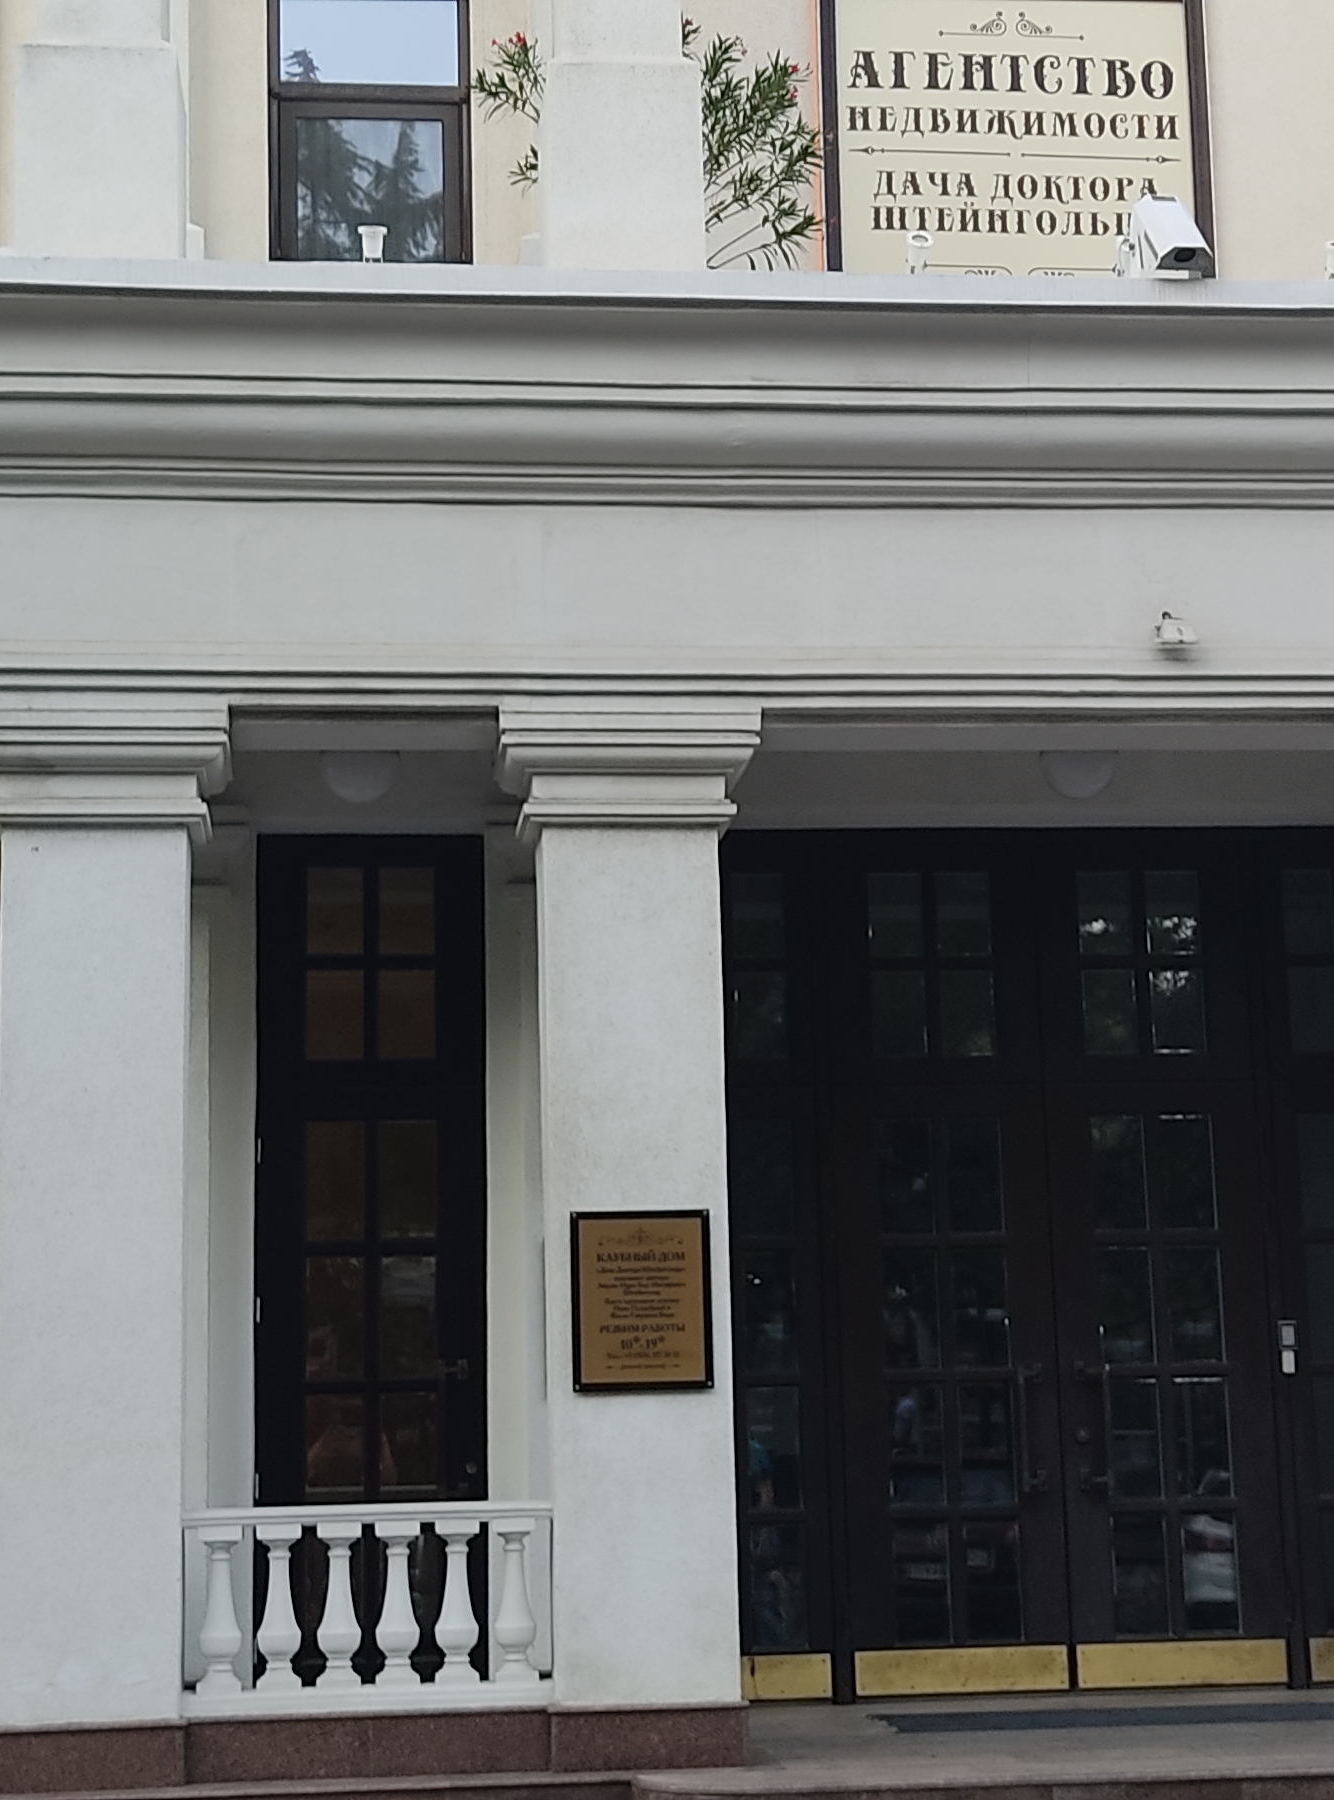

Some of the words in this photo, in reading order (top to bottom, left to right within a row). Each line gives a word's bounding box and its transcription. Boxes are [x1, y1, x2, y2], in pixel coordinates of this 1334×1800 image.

[846, 50, 1174, 99] АГЕНТСТВО
[845, 105, 1181, 140] НЕДВИЖИМОСТИ
[873, 169, 977, 202] ДАЧА
[990, 173, 1158, 205] ДОКТОРА
